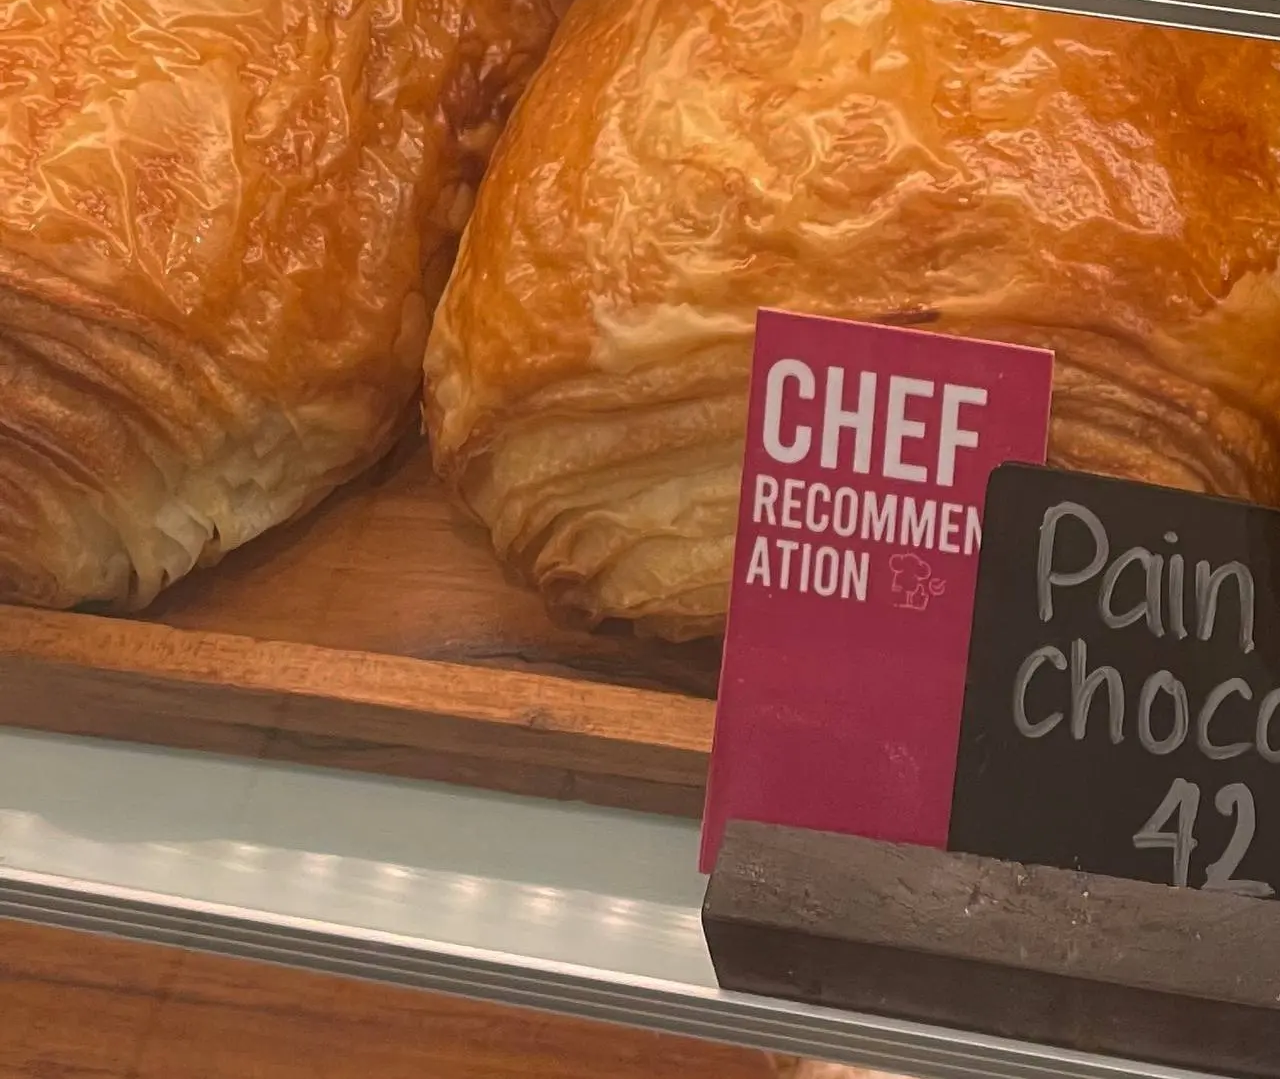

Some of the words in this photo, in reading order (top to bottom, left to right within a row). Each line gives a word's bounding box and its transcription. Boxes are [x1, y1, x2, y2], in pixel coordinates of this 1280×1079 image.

[762, 358, 988, 487] CHEF
[745, 536, 871, 602] ATION
[1038, 501, 1255, 654] Pain
